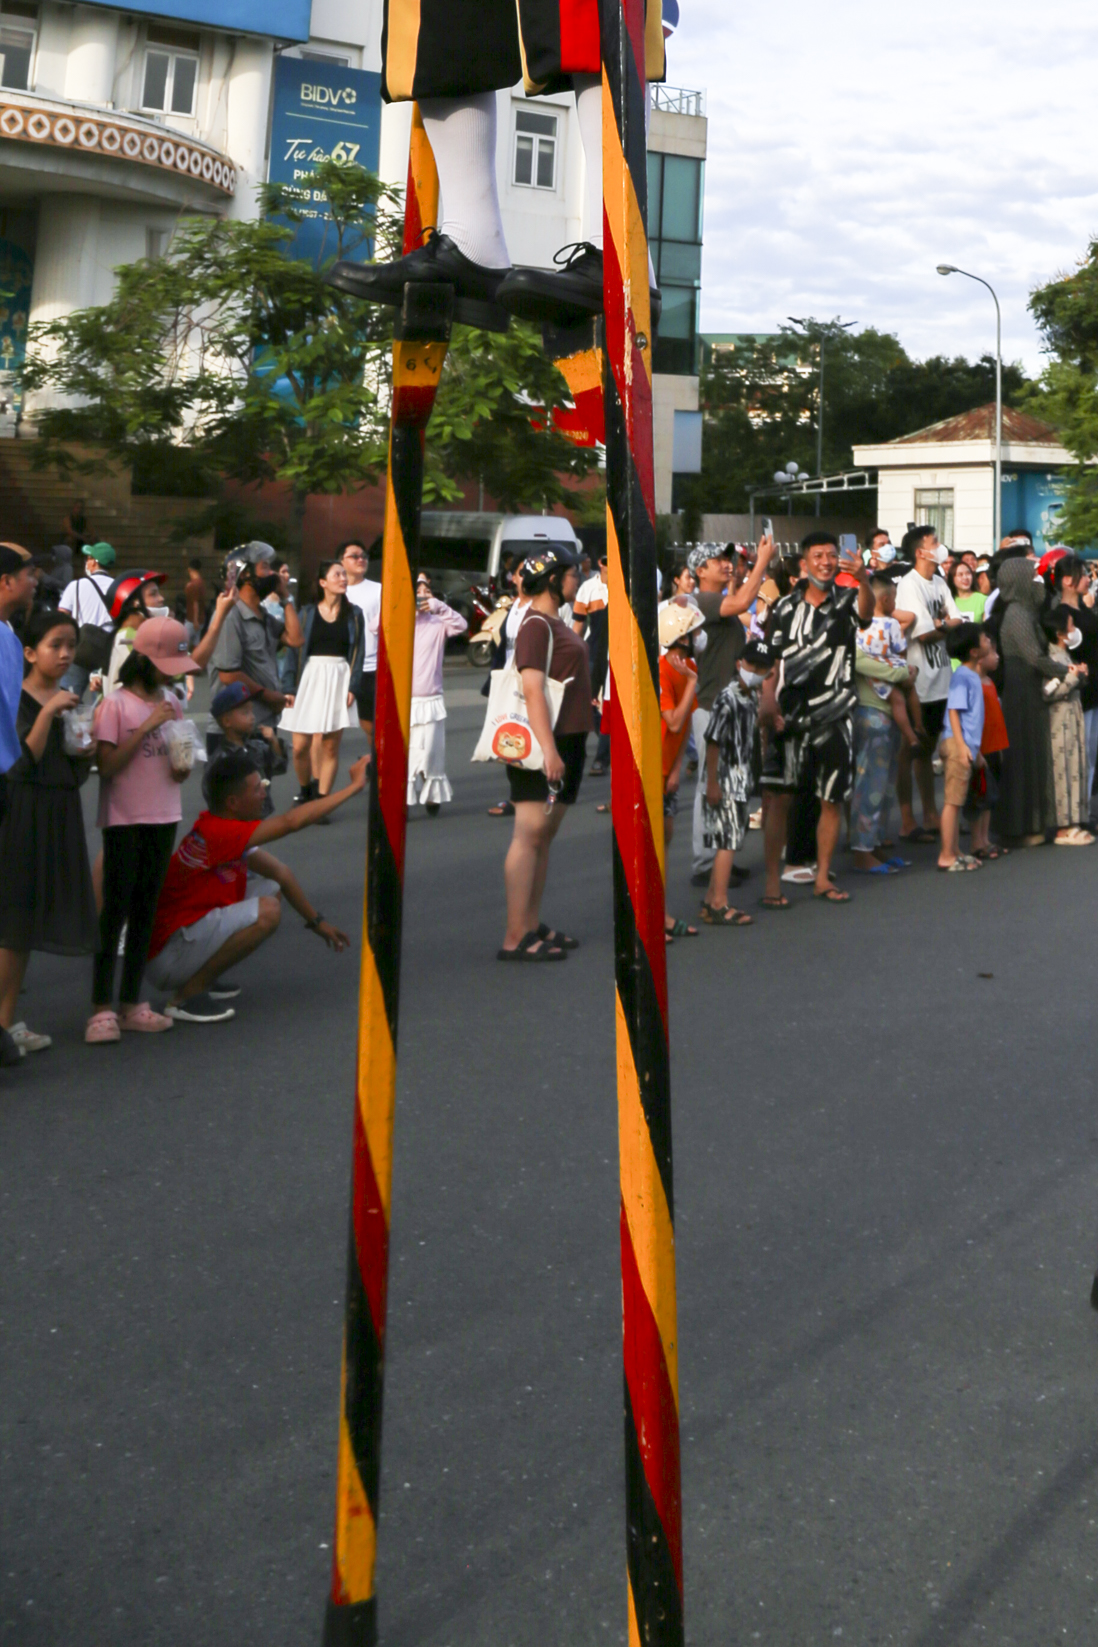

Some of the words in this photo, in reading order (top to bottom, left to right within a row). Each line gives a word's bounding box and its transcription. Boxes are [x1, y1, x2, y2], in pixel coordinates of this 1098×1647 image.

[300, 83, 342, 105] BIDV
[284, 139, 312, 162] Tự
[307, 147, 331, 163] hào
[331, 142, 360, 167] 67
